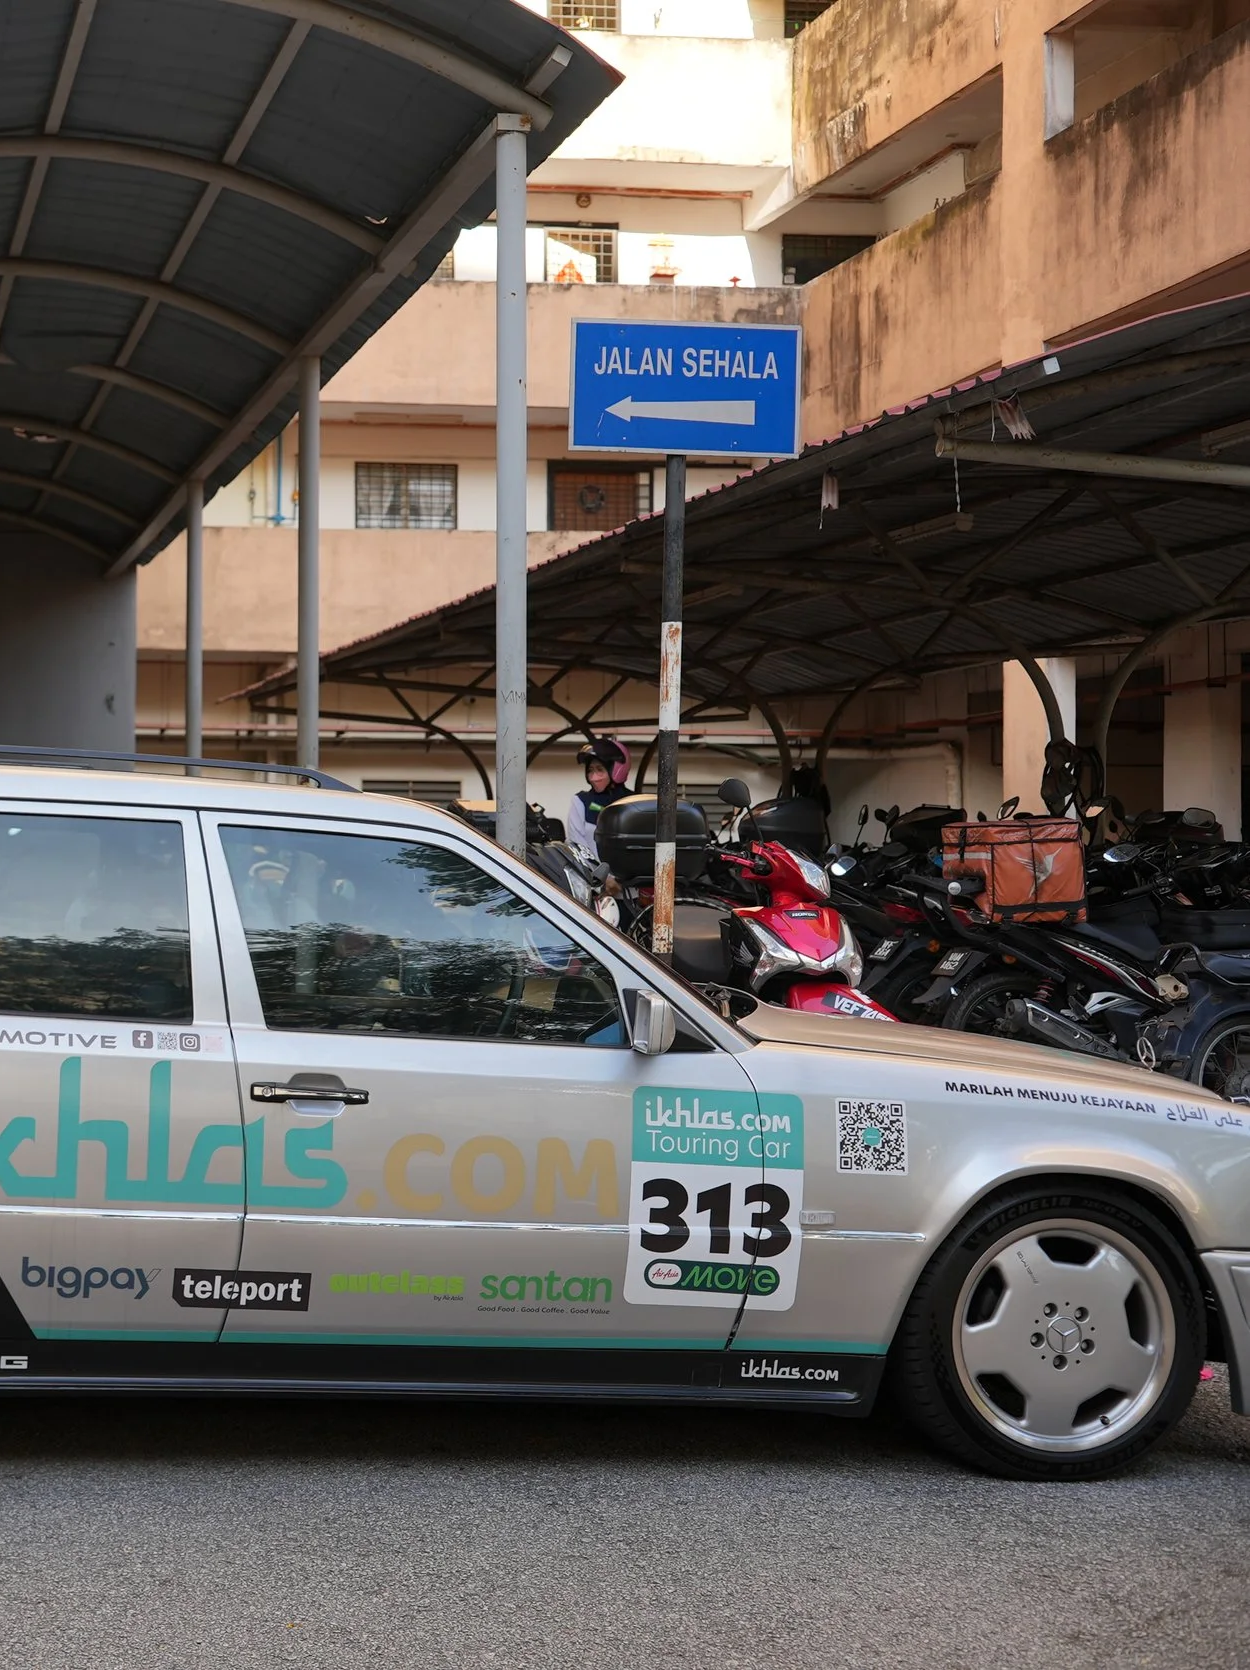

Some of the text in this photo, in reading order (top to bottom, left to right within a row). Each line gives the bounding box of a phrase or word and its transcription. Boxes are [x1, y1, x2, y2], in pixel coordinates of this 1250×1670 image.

[594, 346, 779, 380] JALAN SEHALA
[945, 1081, 1157, 1114] MARILAH MENUJU KEJAYAAN
[646, 1129, 791, 1162] Touring Car
[640, 1178, 792, 1258] 313
[21, 1256, 151, 1299] bigpay
[181, 1275, 303, 1306] teleport
[329, 1270, 466, 1296] outclass
[478, 1270, 613, 1303] santan
[477, 1305, 496, 1313] Good
[497, 1305, 516, 1313] Food
[520, 1306, 540, 1314] Good
[541, 1306, 565, 1314] Coffee
[570, 1307, 589, 1315] Good
